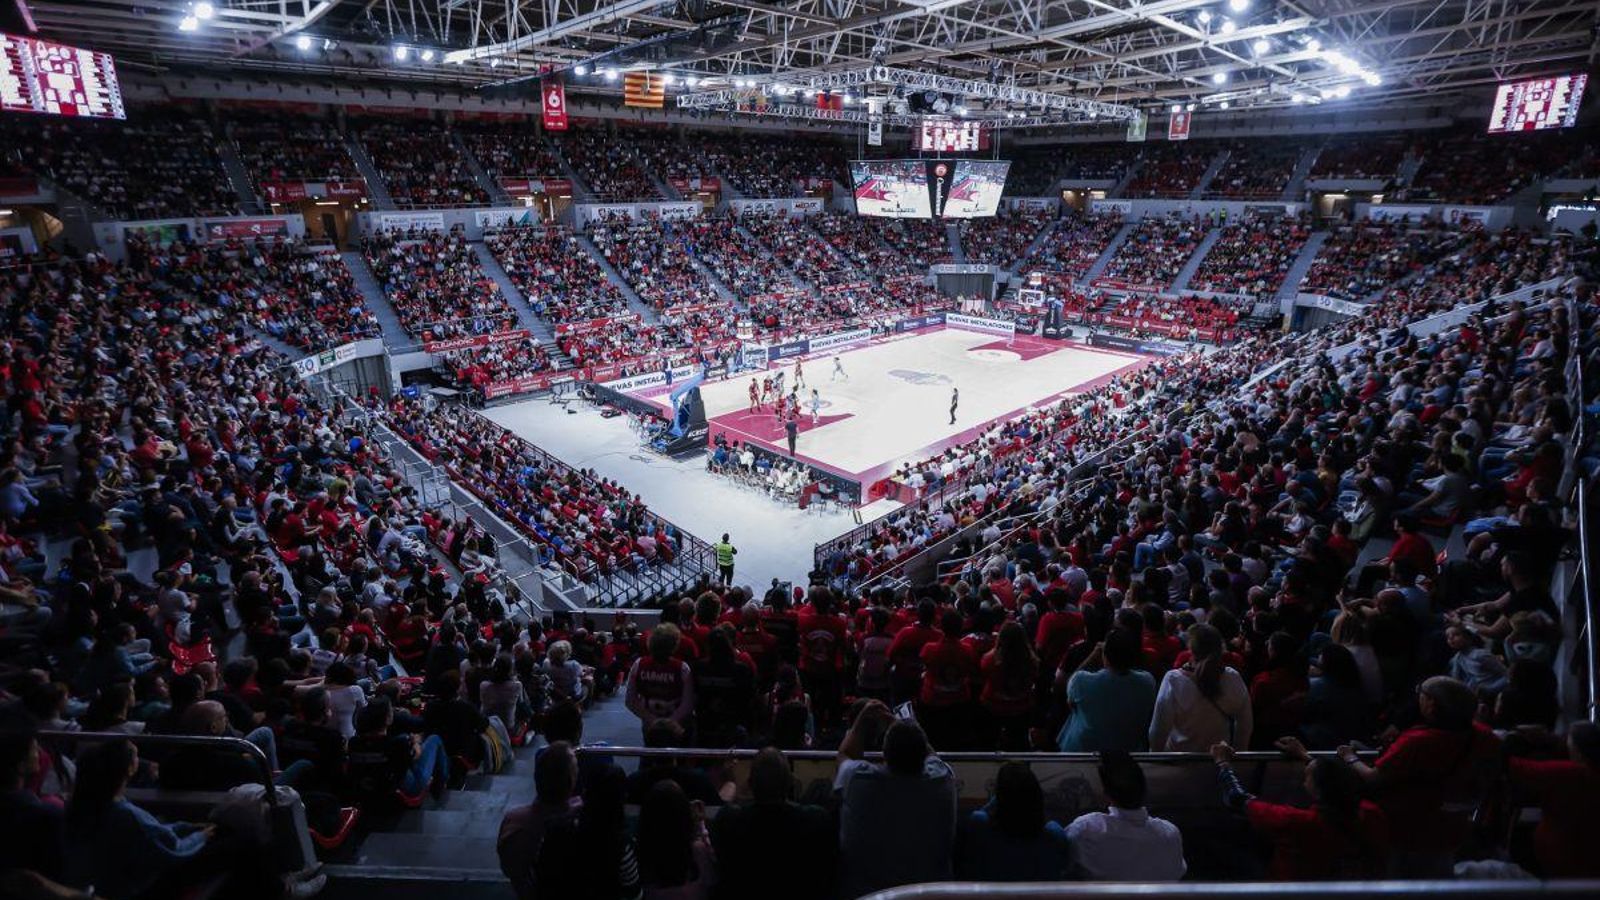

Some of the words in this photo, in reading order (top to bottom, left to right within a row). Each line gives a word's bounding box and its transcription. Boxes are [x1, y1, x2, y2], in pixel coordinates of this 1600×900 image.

[548, 91, 561, 108] 6
[297, 358, 314, 374] 30
[634, 369, 691, 387] INSTALAONES
[640, 670, 674, 682] CARMEN
